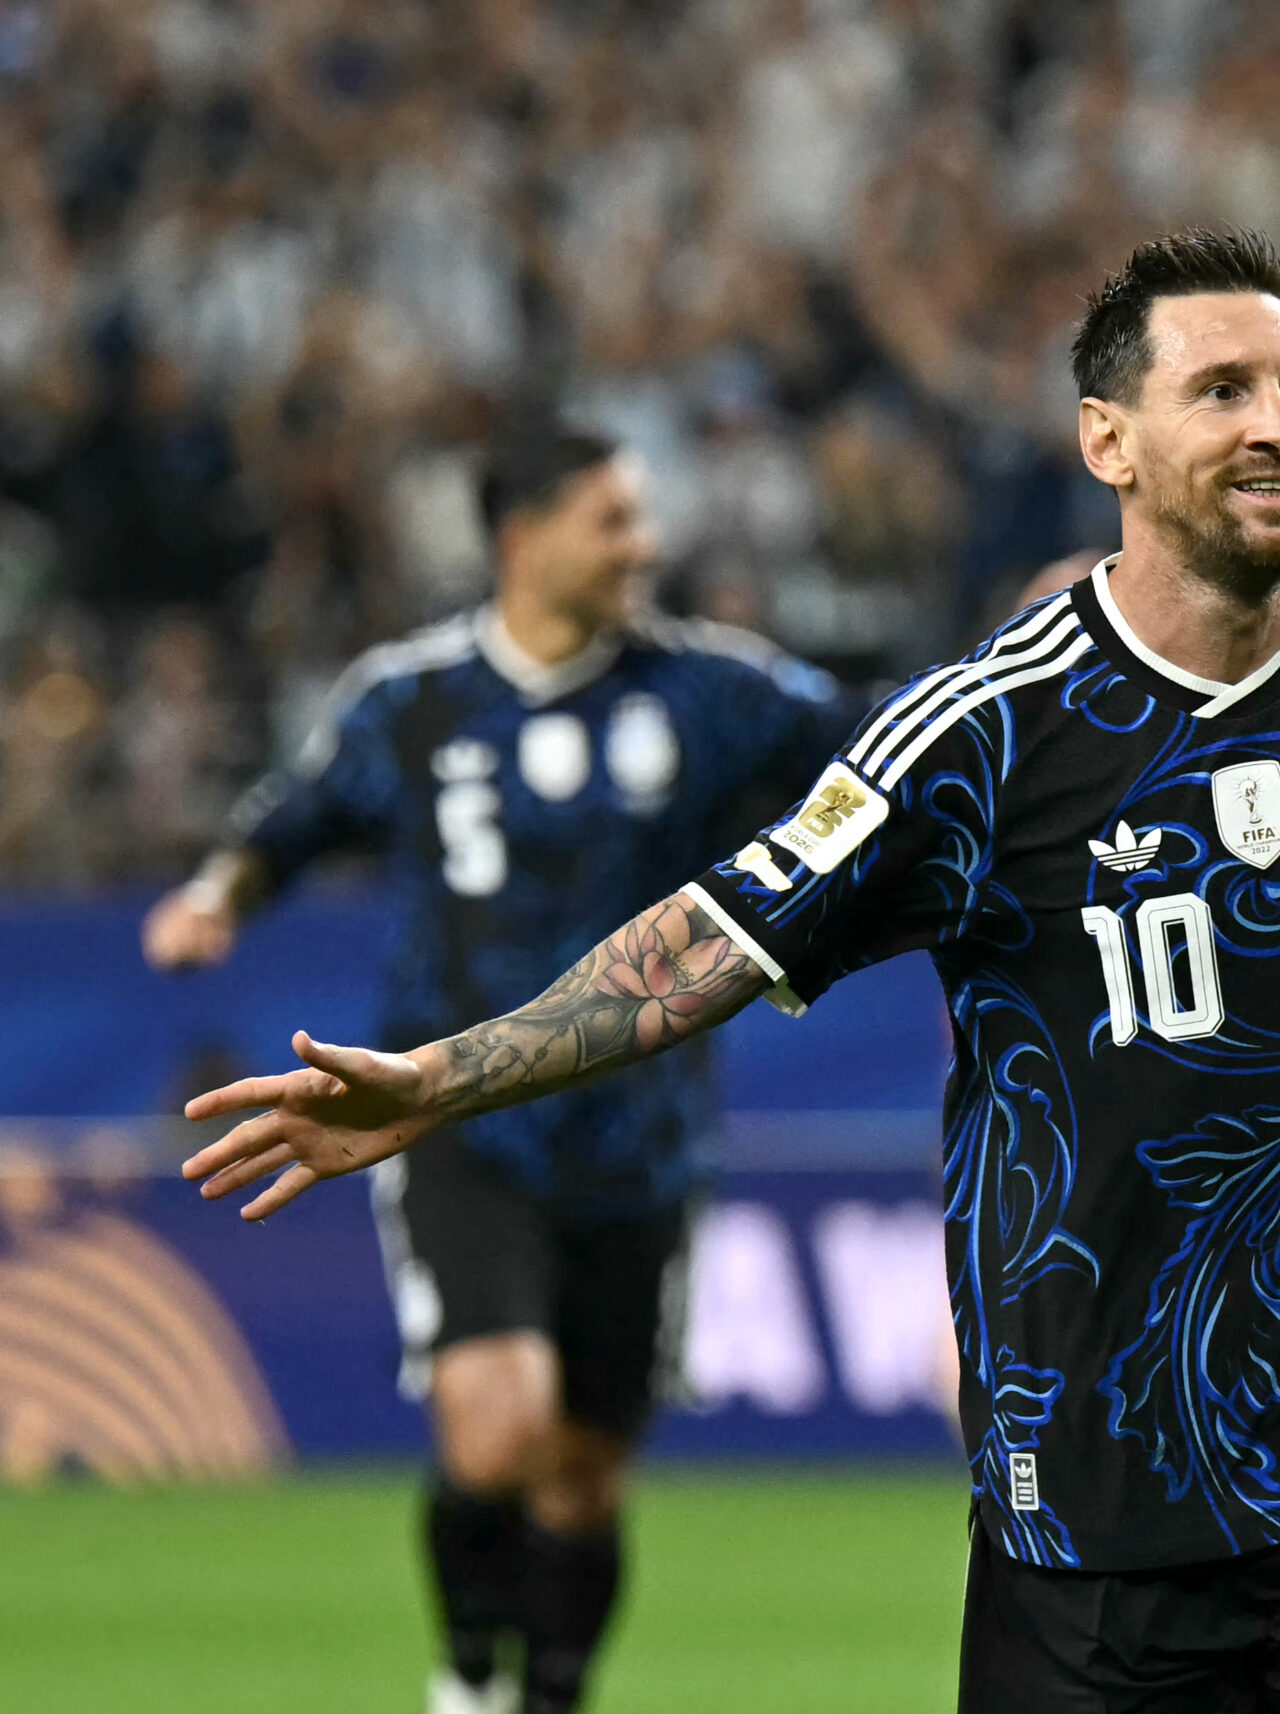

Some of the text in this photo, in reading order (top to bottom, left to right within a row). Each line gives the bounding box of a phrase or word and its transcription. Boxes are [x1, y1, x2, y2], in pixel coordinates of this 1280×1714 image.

[783, 829, 815, 854] 2026
[1242, 826, 1276, 843] FIFA
[1252, 845, 1271, 855] 2022
[1081, 892, 1225, 1047] 10
